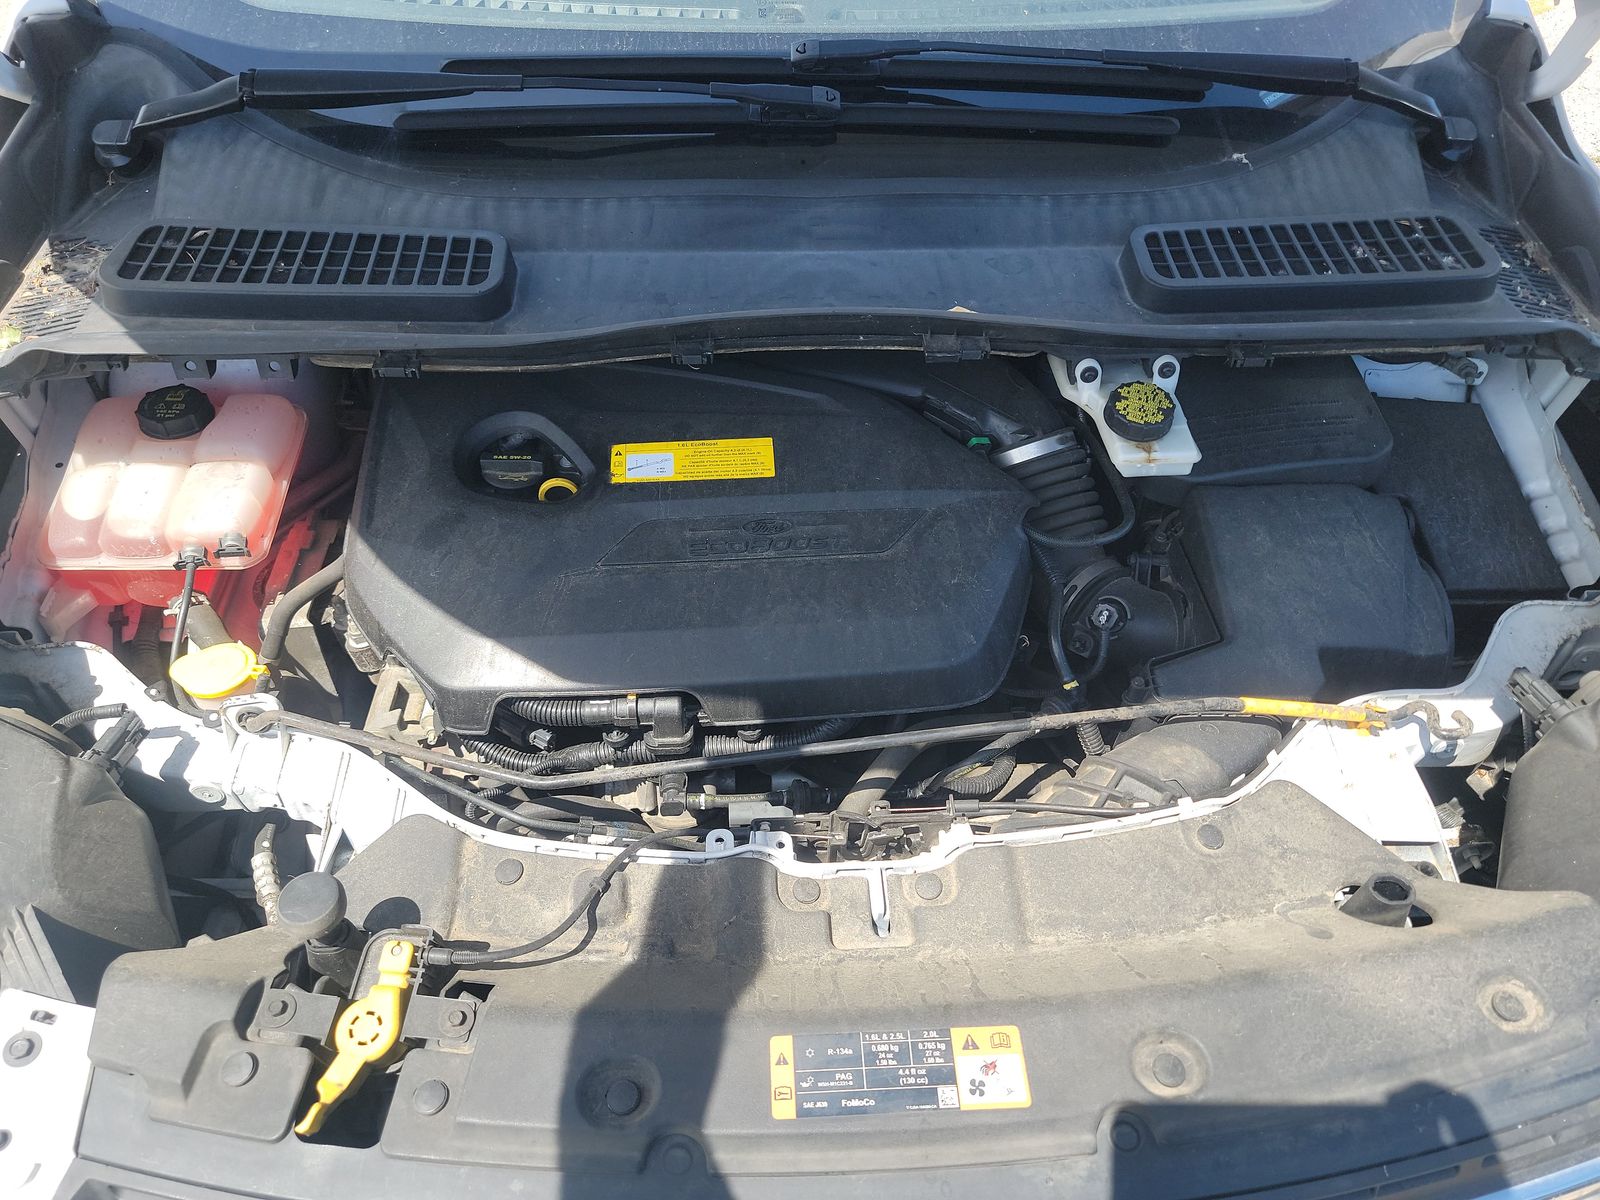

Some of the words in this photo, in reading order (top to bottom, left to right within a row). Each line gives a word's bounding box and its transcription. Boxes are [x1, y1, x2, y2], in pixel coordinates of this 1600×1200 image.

[865, 1033, 881, 1041] 1.6L
[889, 1032, 906, 1040] 2.5L
[923, 1030, 939, 1038] 2.0L
[871, 1044, 889, 1052] 0.680
[890, 1044, 899, 1053] kg
[918, 1042, 936, 1050] 0.765
[937, 1041, 946, 1051] kg
[827, 1048, 853, 1056] R-134a
[835, 1072, 853, 1080] PAG
[899, 1077, 915, 1086] (130
[917, 1076, 928, 1085] cc)
[841, 1098, 875, 1107] FoMoCo
